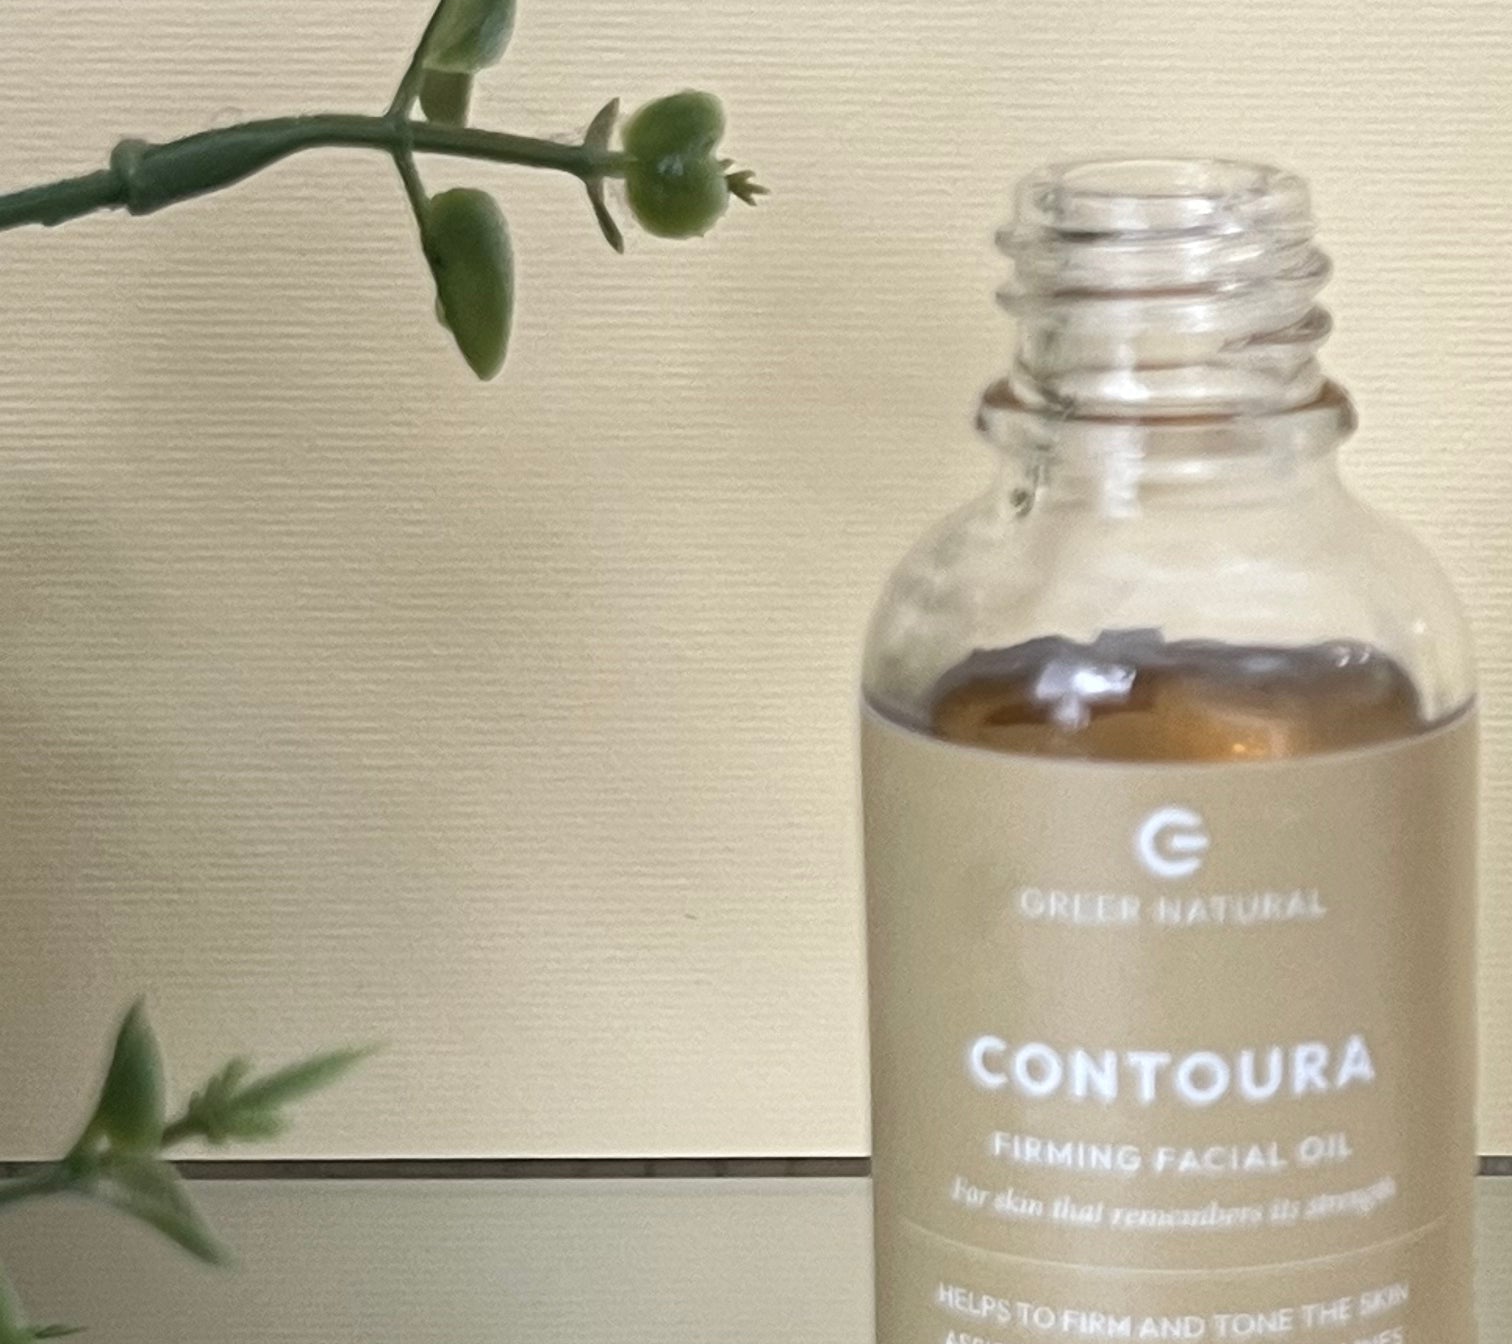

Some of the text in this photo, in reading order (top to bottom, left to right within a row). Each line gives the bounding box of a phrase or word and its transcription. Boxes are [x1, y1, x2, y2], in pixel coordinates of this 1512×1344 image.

[1158, 889, 1326, 924] NATURAL
[968, 1035, 1375, 1102] CONTOURA
[991, 1131, 1352, 1174] FIRMING FACIAL OIL
[952, 1178, 989, 1206] For
[994, 1188, 1042, 1217] skin
[1052, 1195, 1102, 1224] that
[938, 1283, 1409, 1338] HELPS TO FIRM AND TONE THE SKIN
